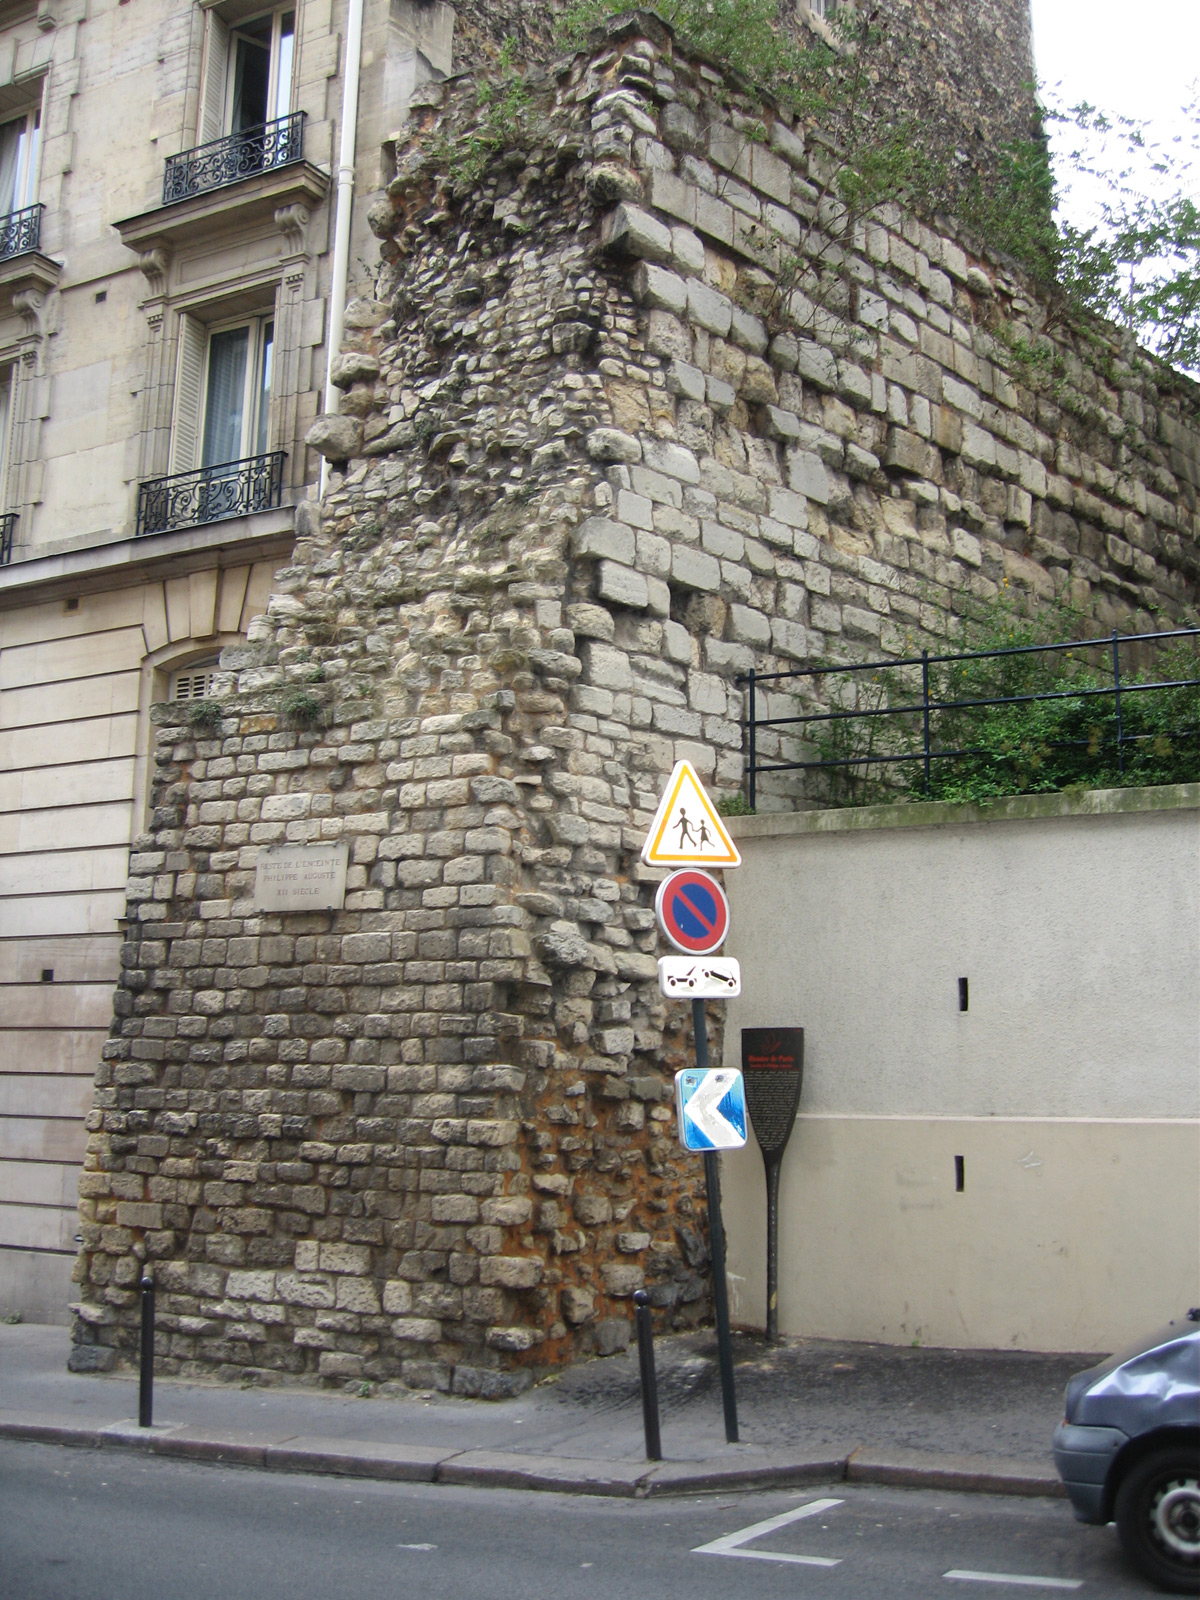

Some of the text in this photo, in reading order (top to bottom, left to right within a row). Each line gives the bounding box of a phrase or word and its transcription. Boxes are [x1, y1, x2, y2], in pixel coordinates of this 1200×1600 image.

[260, 859, 341, 870] RESTE DE L'ENCEINTE
[264, 872, 336, 881] PHILIPPE AUGUSTE
